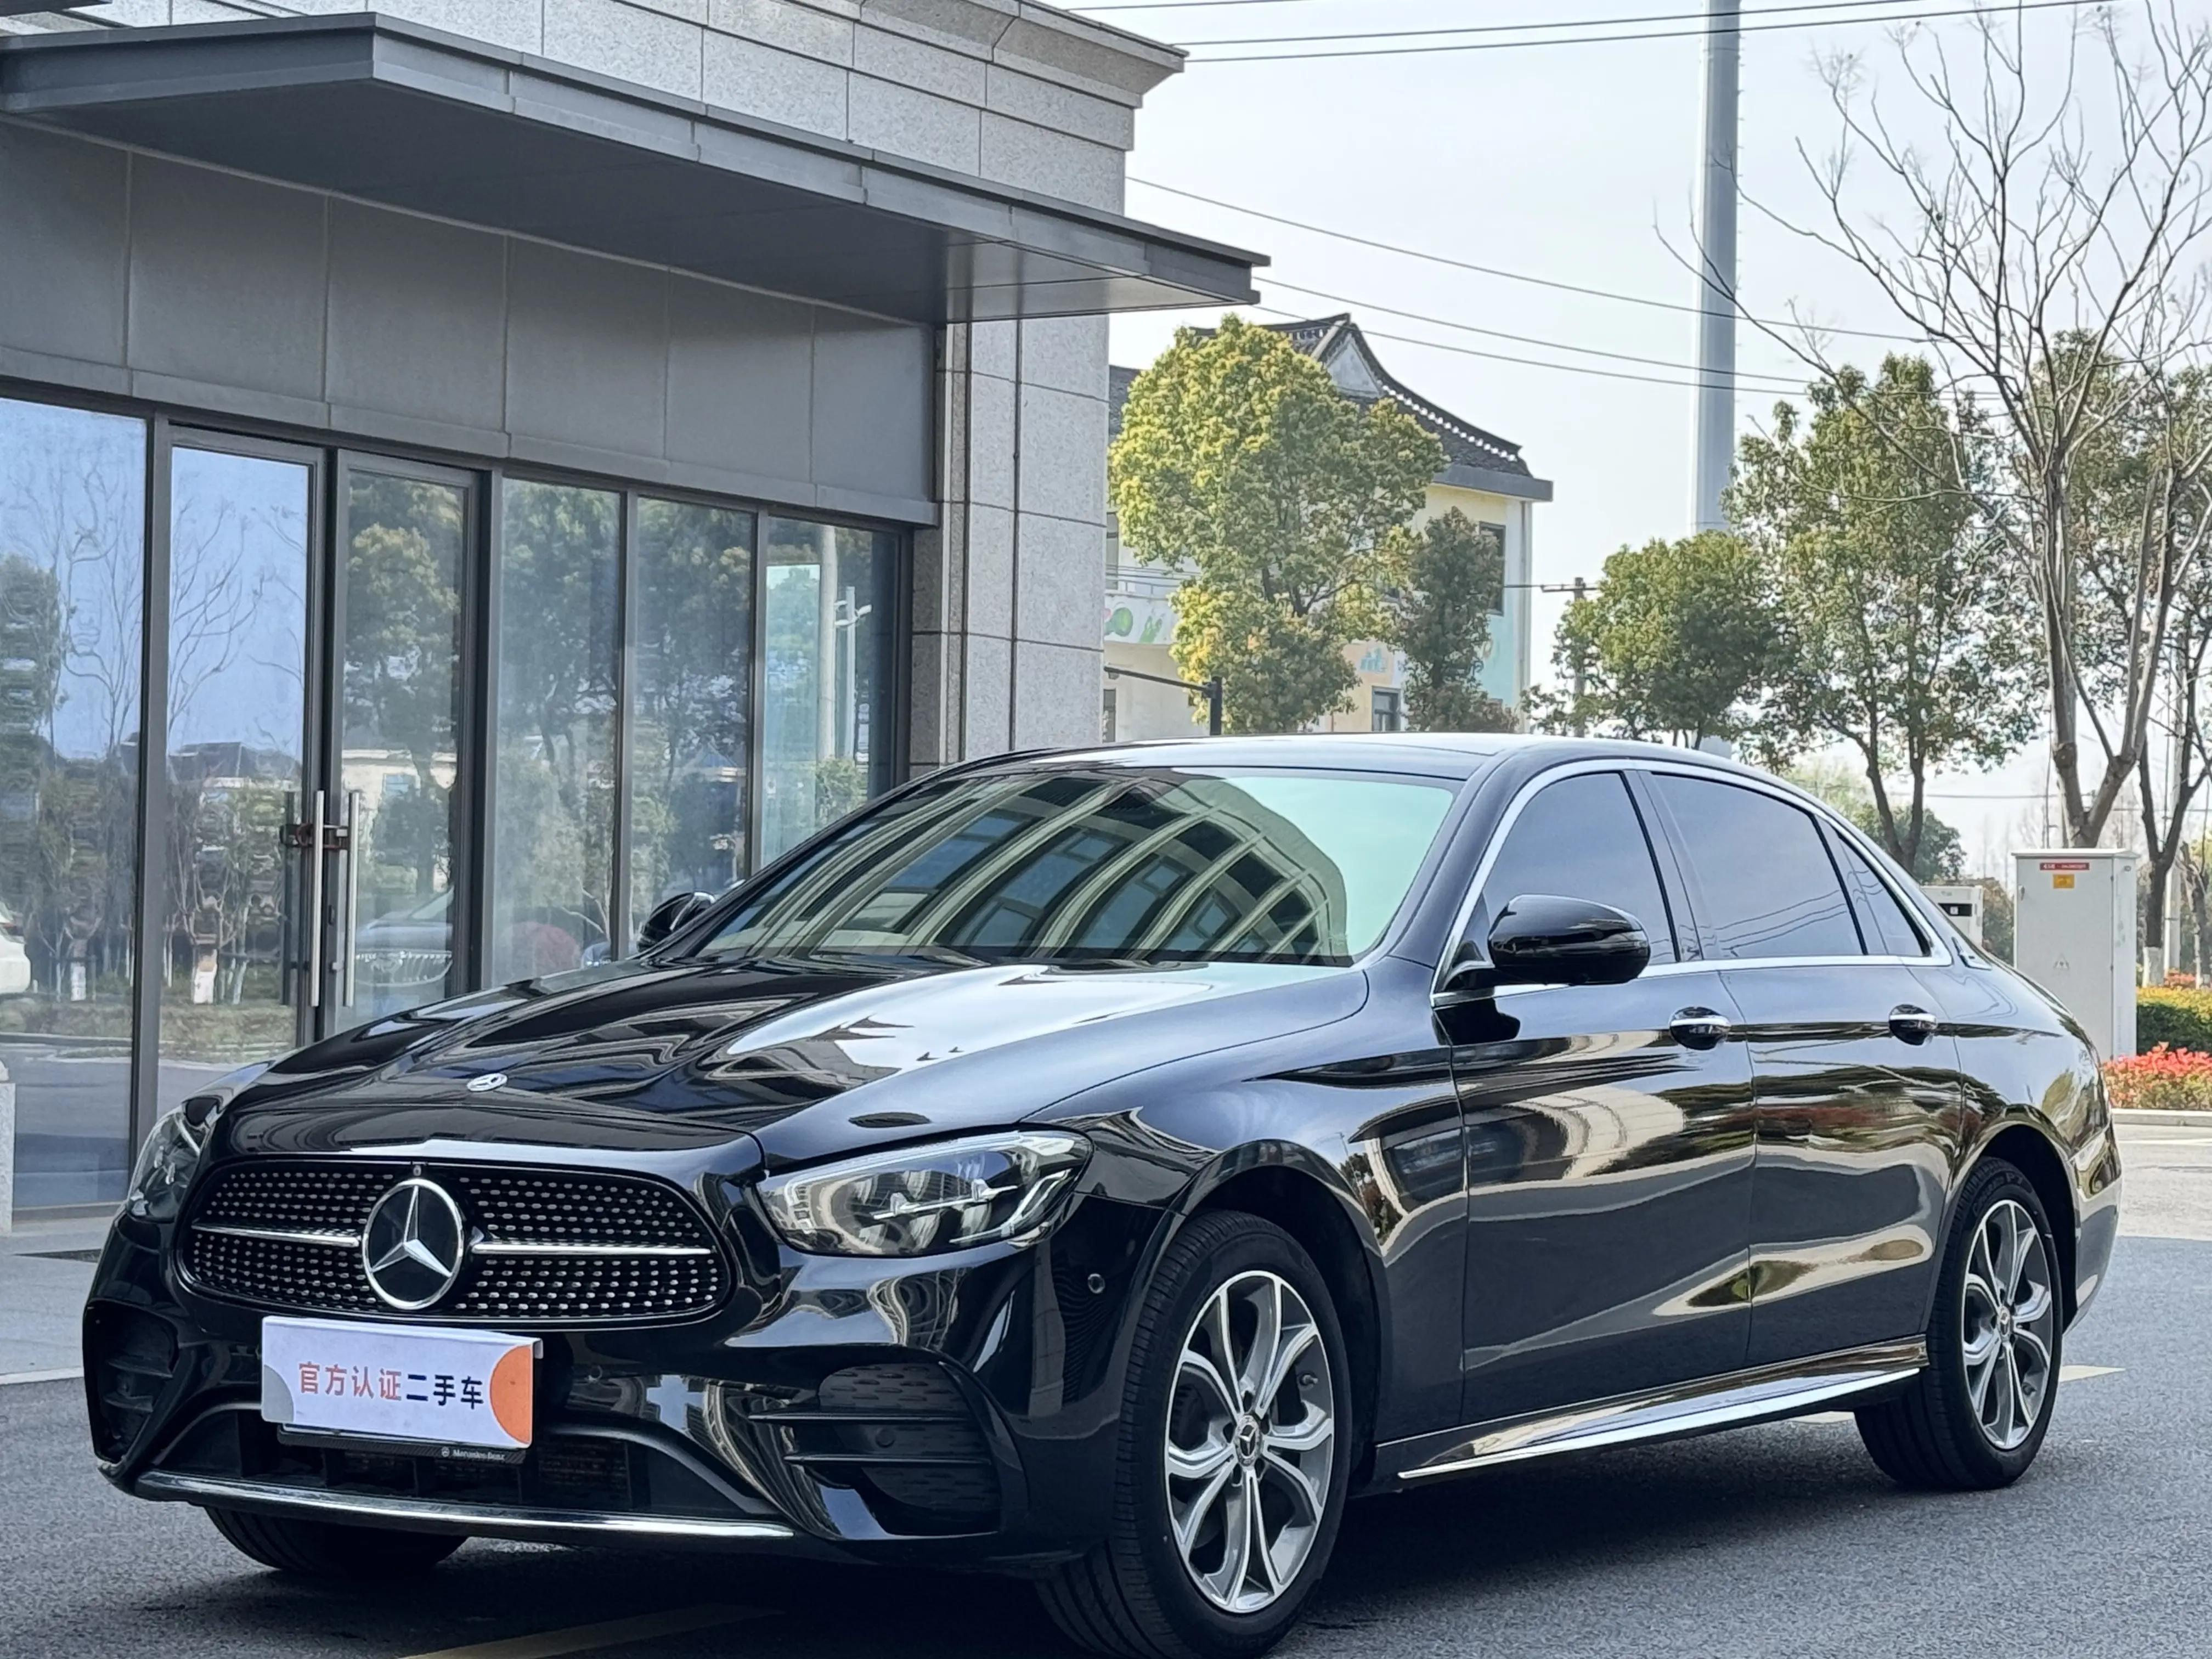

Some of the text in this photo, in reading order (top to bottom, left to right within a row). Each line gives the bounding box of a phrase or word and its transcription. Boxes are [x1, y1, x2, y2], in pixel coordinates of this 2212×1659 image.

[298, 1361, 484, 1409] 官方认证二手车
